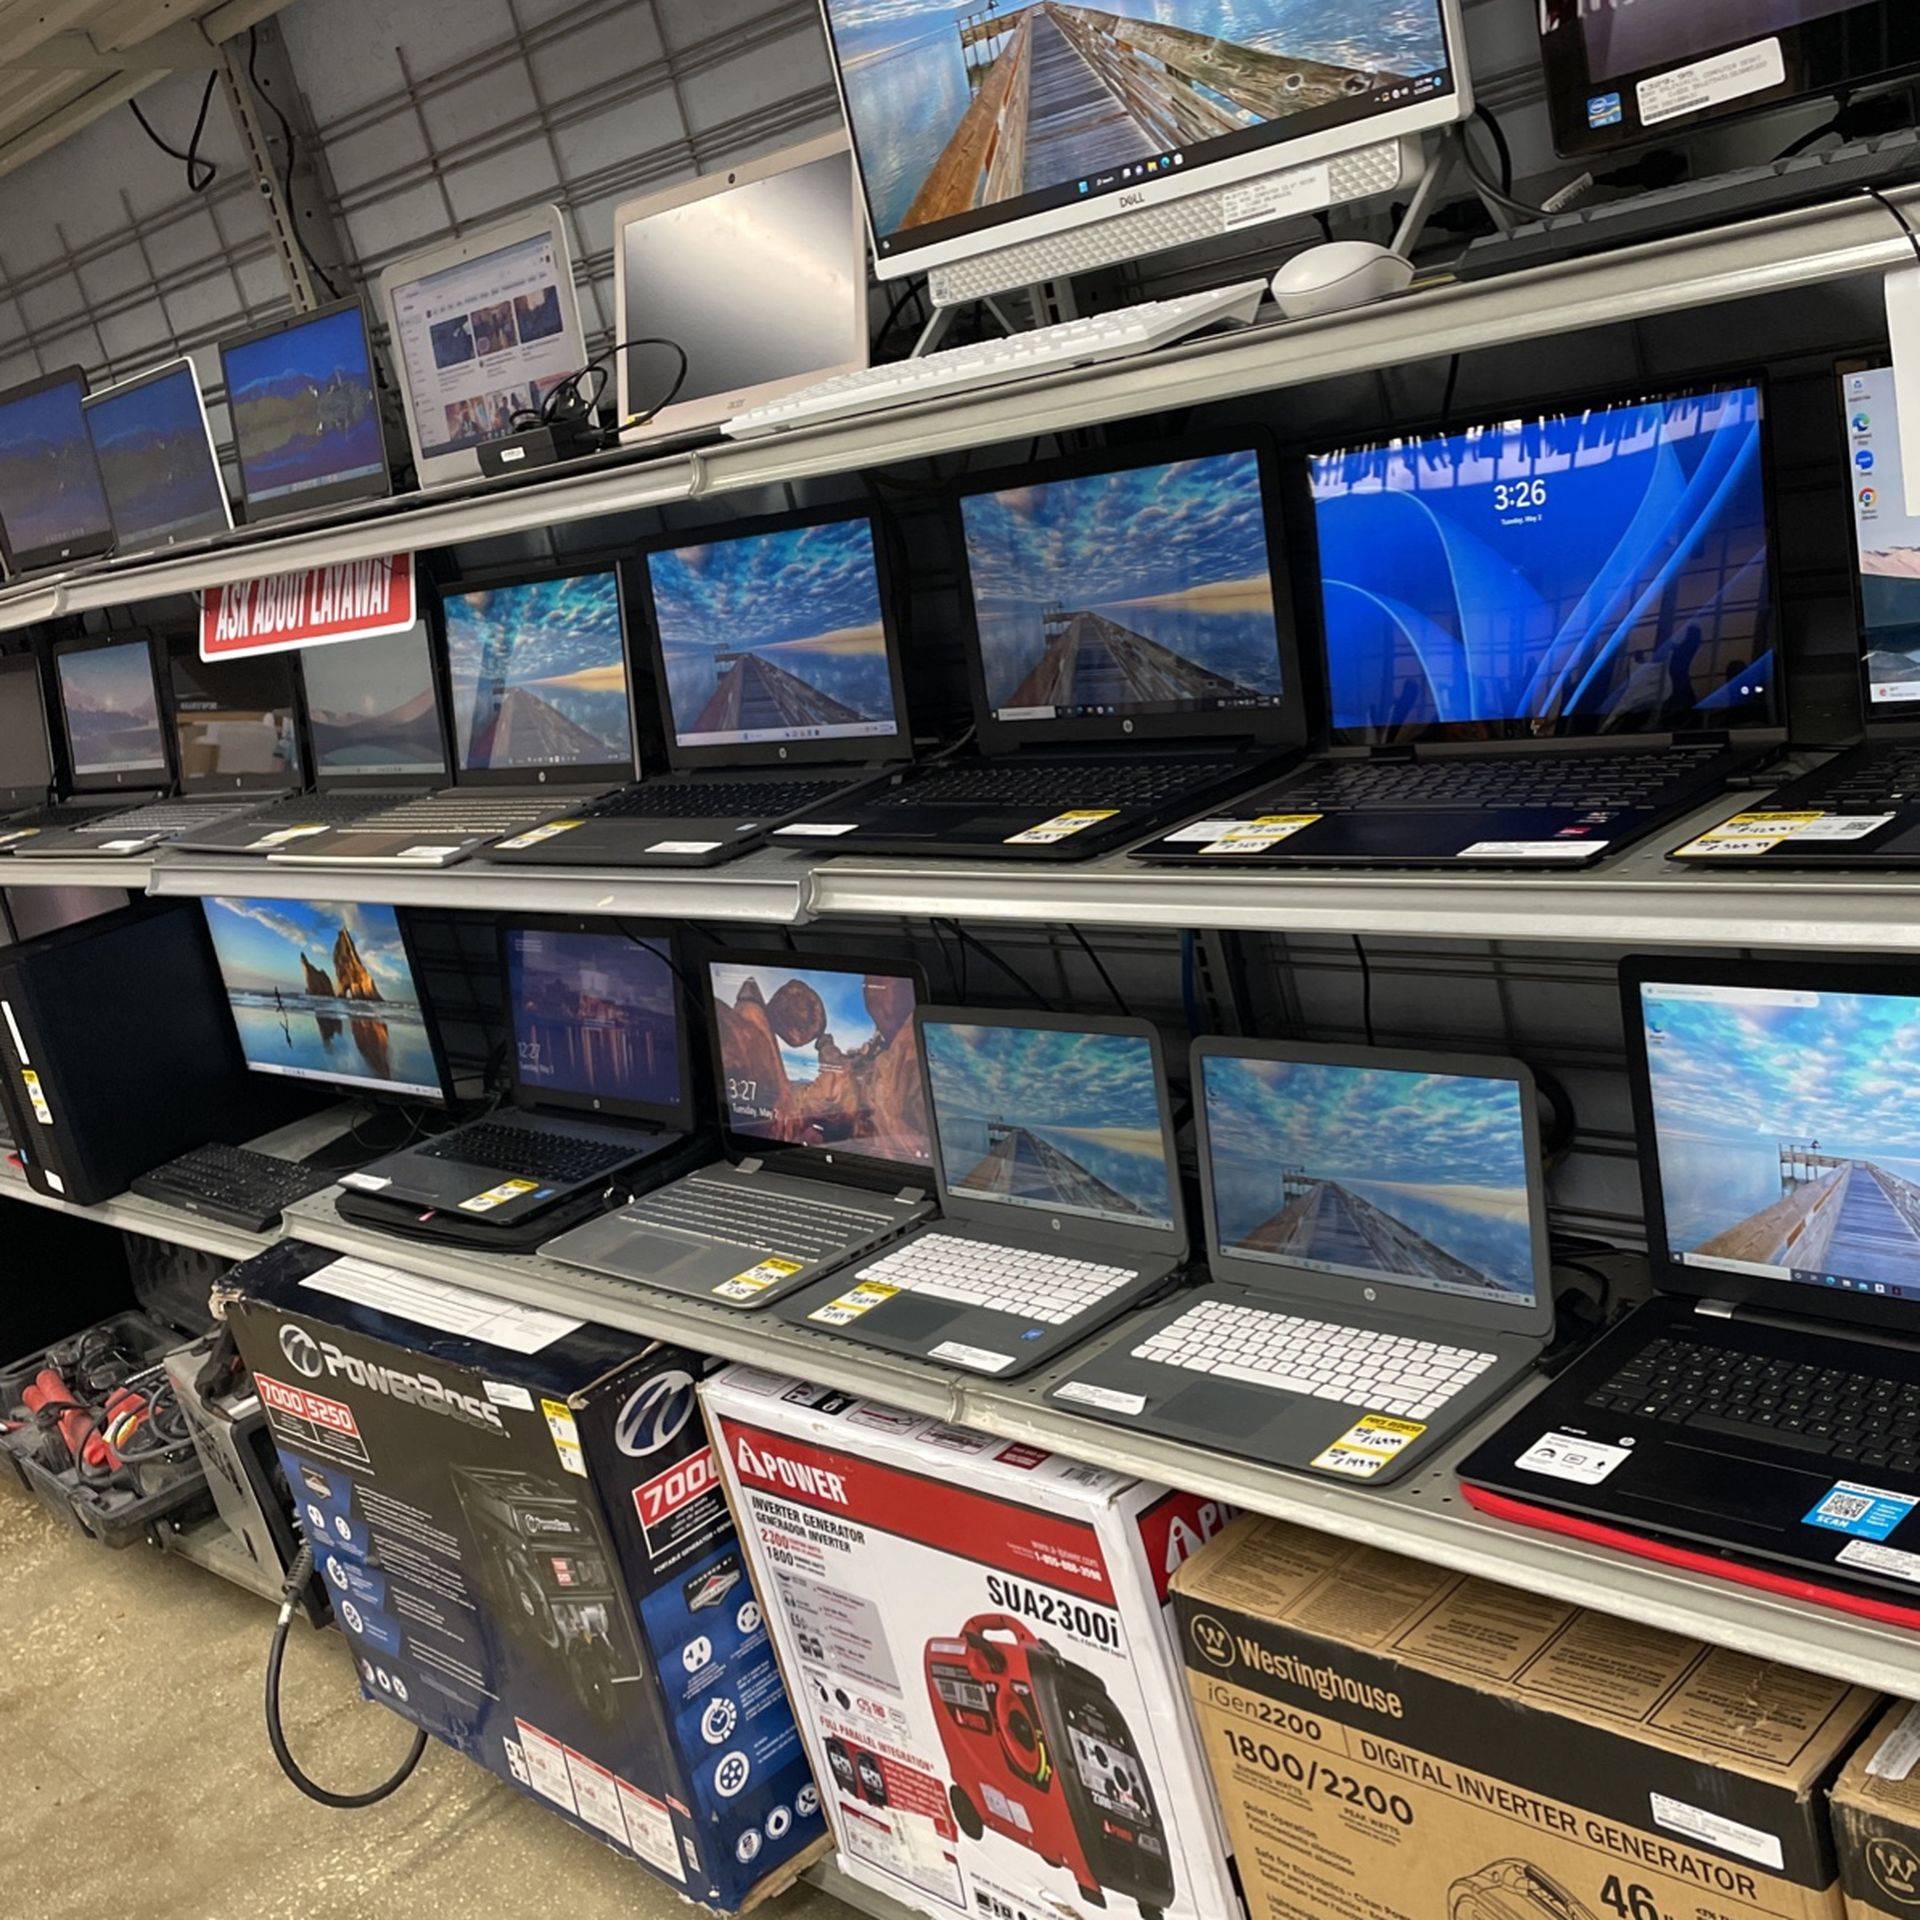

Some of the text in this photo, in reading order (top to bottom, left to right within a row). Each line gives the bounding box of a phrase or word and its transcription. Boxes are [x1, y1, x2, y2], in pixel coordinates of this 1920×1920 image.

[1119, 192, 1145, 208] DELL
[1494, 479, 1547, 511] 3:26
[215, 554, 394, 641] ASK ABOUT LAYAWAY
[729, 1078, 758, 1101] 3:27
[732, 1103, 758, 1118] Tuesday,
[759, 1107, 774, 1120] May
[259, 1380, 352, 1429] 7000 5250
[752, 1495, 800, 1522] INVERTER
[803, 1510, 866, 1545] GENERATOR
[755, 1511, 807, 1538] GENERADOR
[808, 1529, 852, 1553] INVERTER
[1815, 1515, 1850, 1528] SCAN
[767, 1546, 794, 1566] 1800
[986, 1575, 1120, 1648] SUA2300i
[1236, 1636, 1404, 1719] Westinghouse
[1208, 1682, 1322, 1741] iGen2200
[1224, 1729, 1414, 1826] 1800/2200
[1360, 1738, 1453, 1790] DIGITAL
[1455, 1772, 1579, 1838] INVERTER
[1584, 1820, 1758, 1900] GENERATOR
[1601, 1874, 1660, 1920] 46
